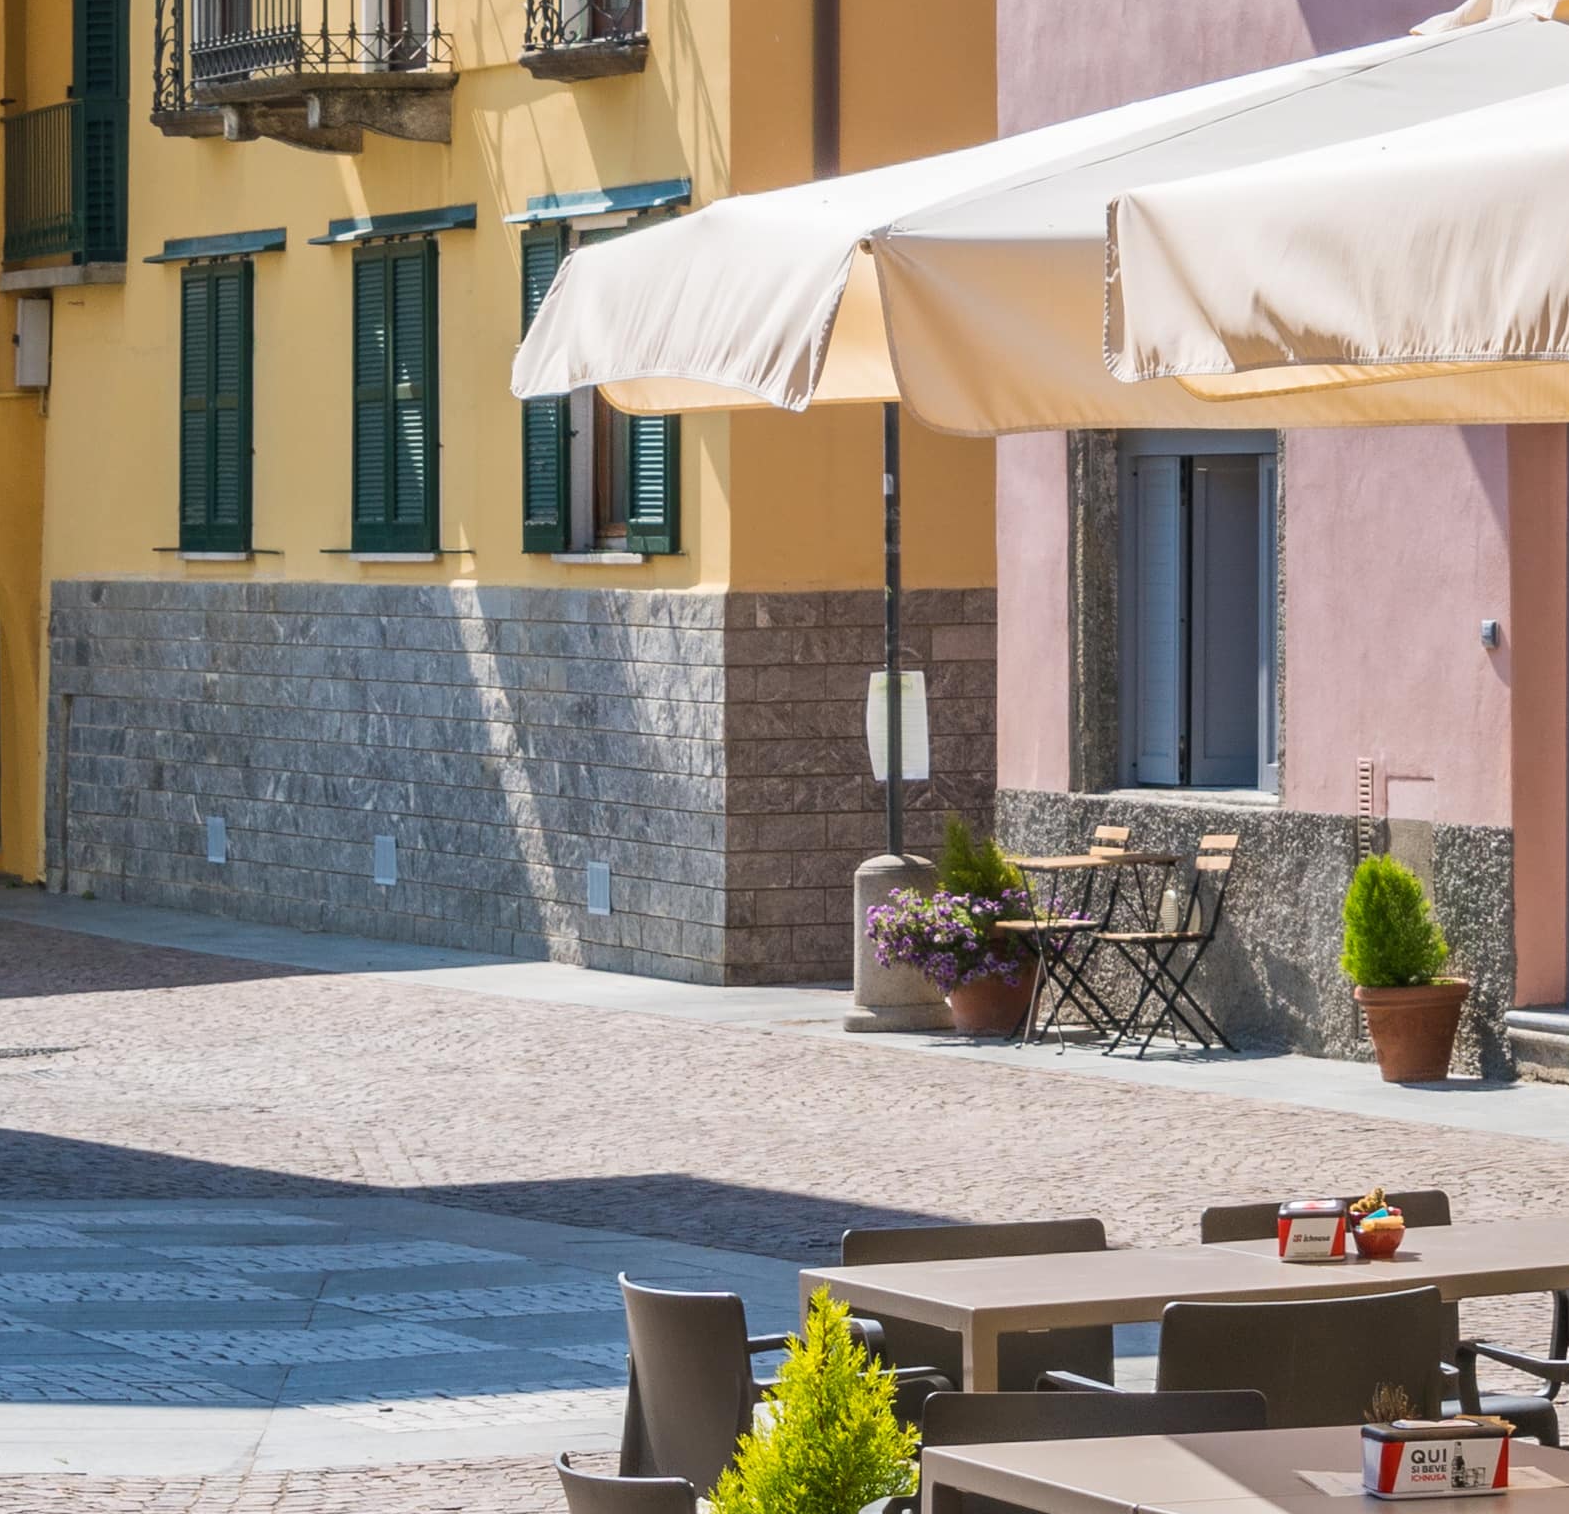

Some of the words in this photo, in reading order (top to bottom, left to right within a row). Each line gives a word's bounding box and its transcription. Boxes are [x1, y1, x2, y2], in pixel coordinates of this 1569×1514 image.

[1411, 1448, 1447, 1464] QUI
[1411, 1465, 1420, 1473] SI
[1422, 1464, 1447, 1473] BEVE
[1411, 1473, 1447, 1482] ICHNUSA
